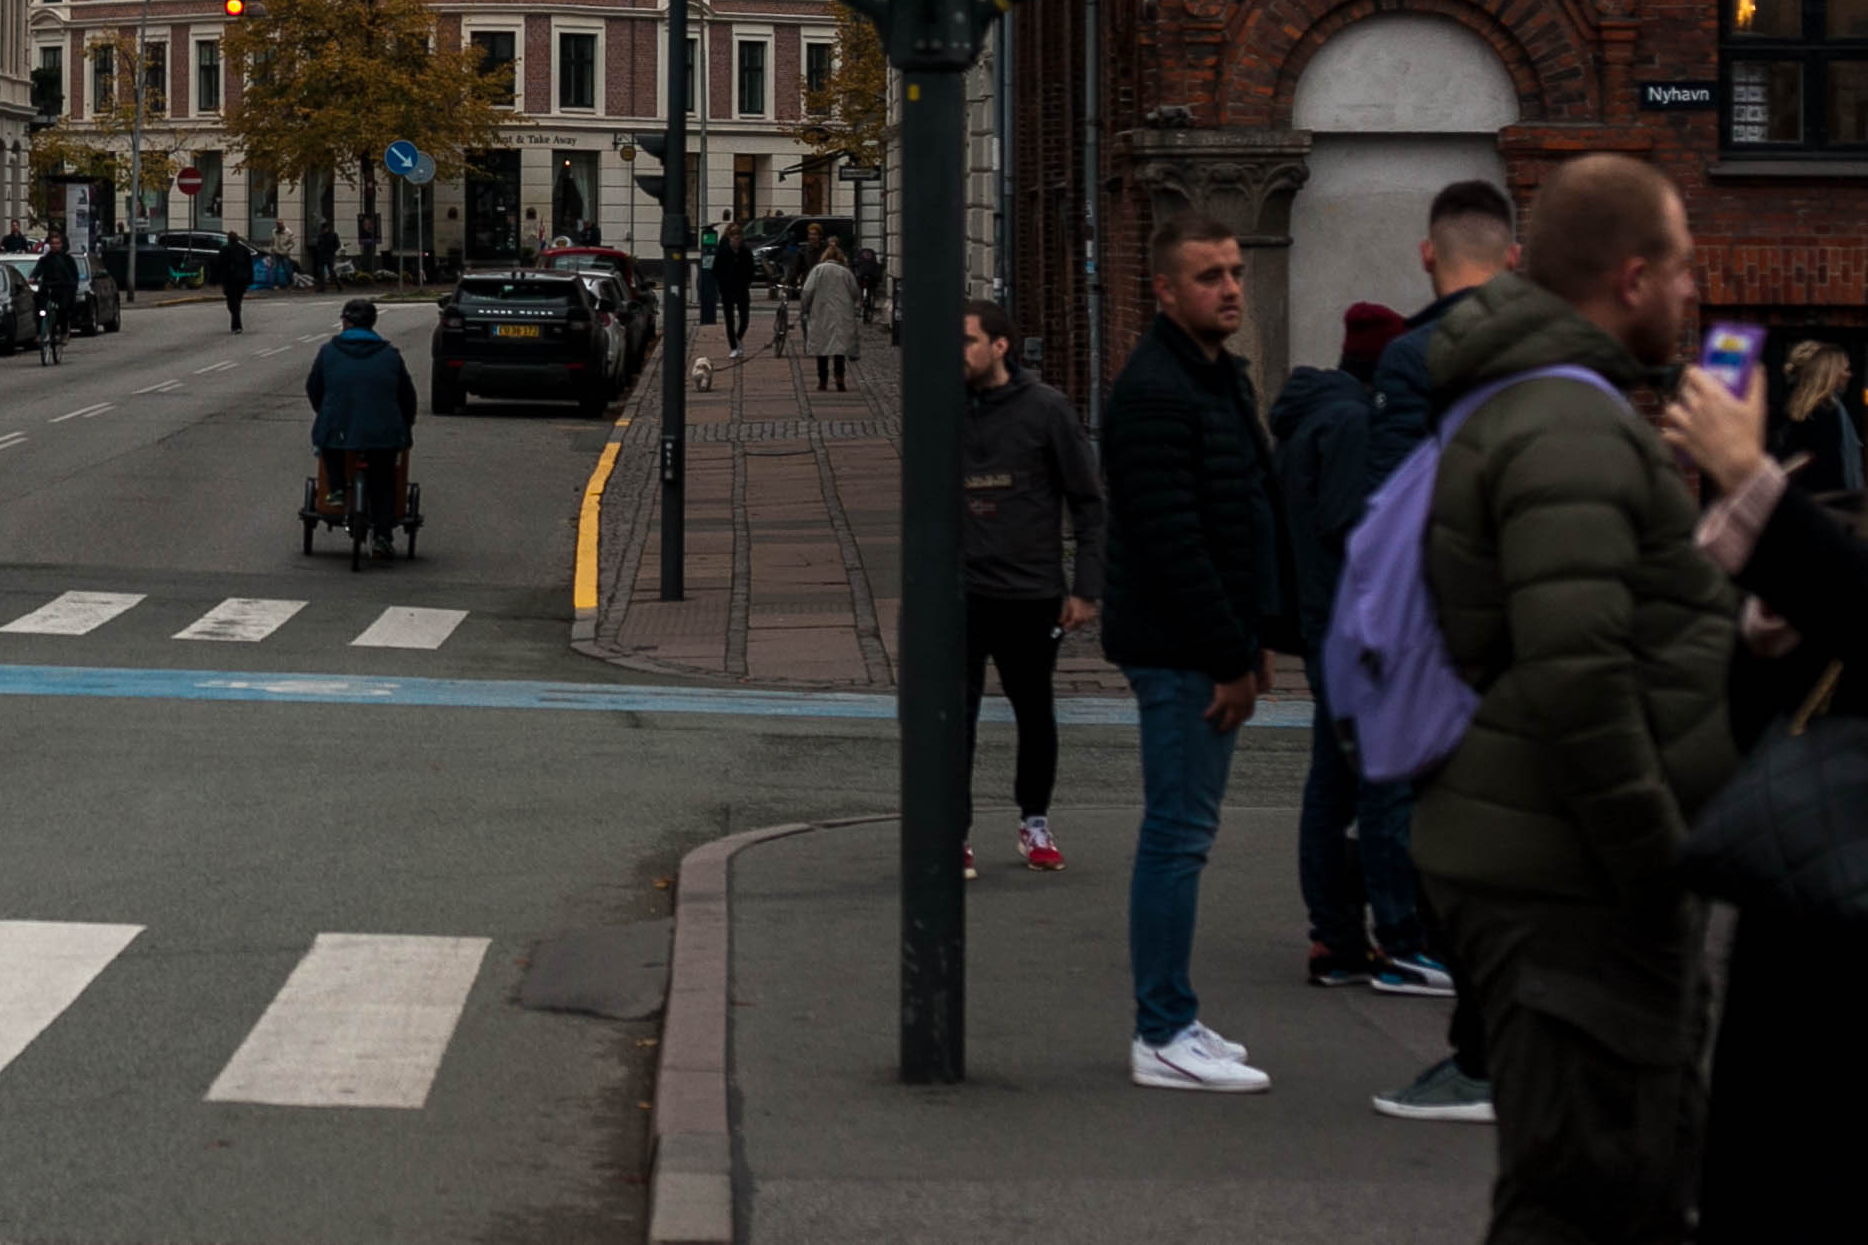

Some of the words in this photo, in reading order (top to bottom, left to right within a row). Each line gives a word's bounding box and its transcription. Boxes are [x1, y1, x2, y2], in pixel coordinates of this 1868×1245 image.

[1647, 86, 1710, 104] Nyhavn
[515, 135, 525, 144] &
[528, 134, 550, 144] Take
[553, 135, 577, 146] Away
